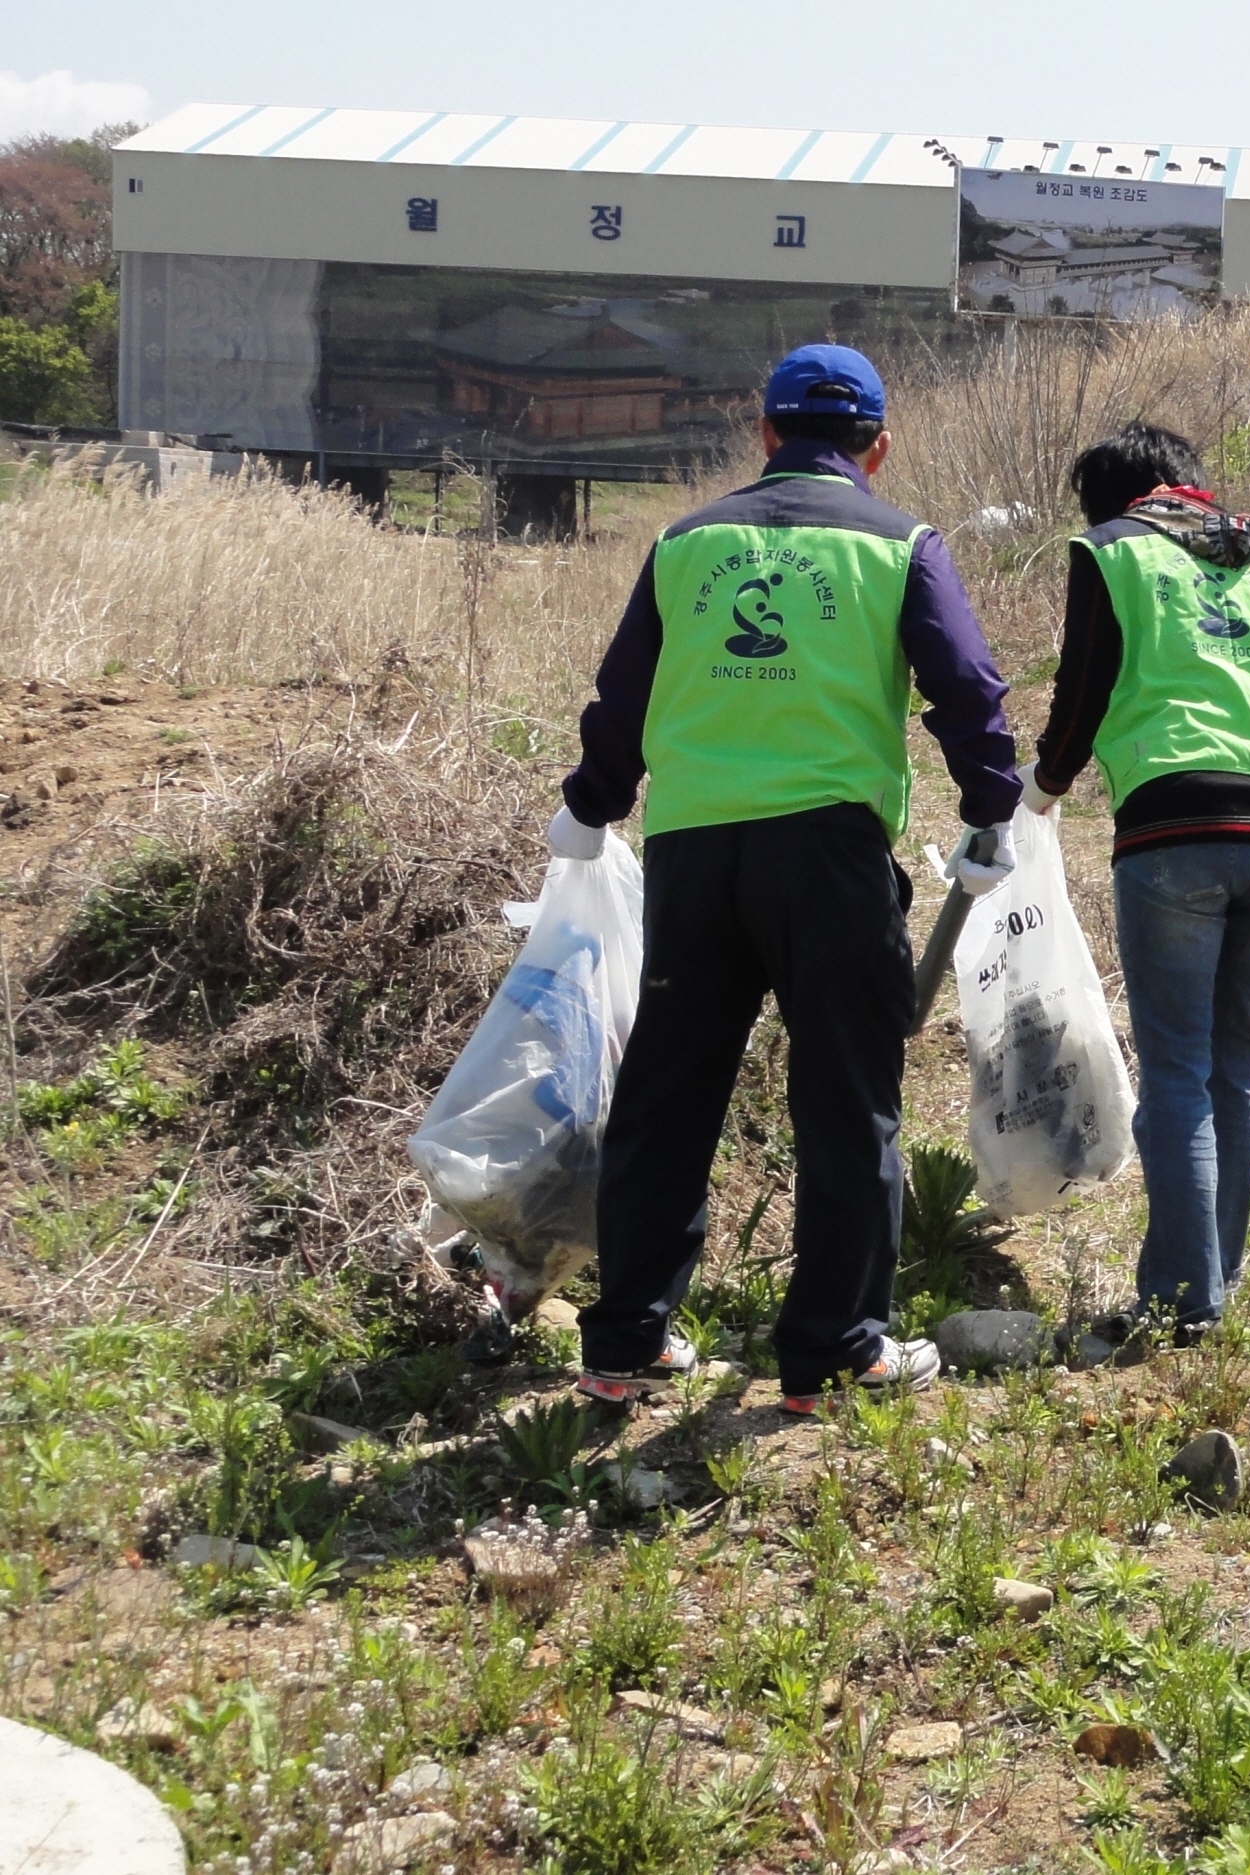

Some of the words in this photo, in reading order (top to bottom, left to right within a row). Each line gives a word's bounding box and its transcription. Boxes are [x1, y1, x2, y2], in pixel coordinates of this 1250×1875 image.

[1035, 181, 1074, 198] 월정교
[1079, 184, 1105, 200] 복원
[1110, 187, 1148, 203] 조감도
[1191, 642, 1226, 656] SINCE
[711, 665, 753, 680] SINCE
[758, 667, 797, 681] 2003
